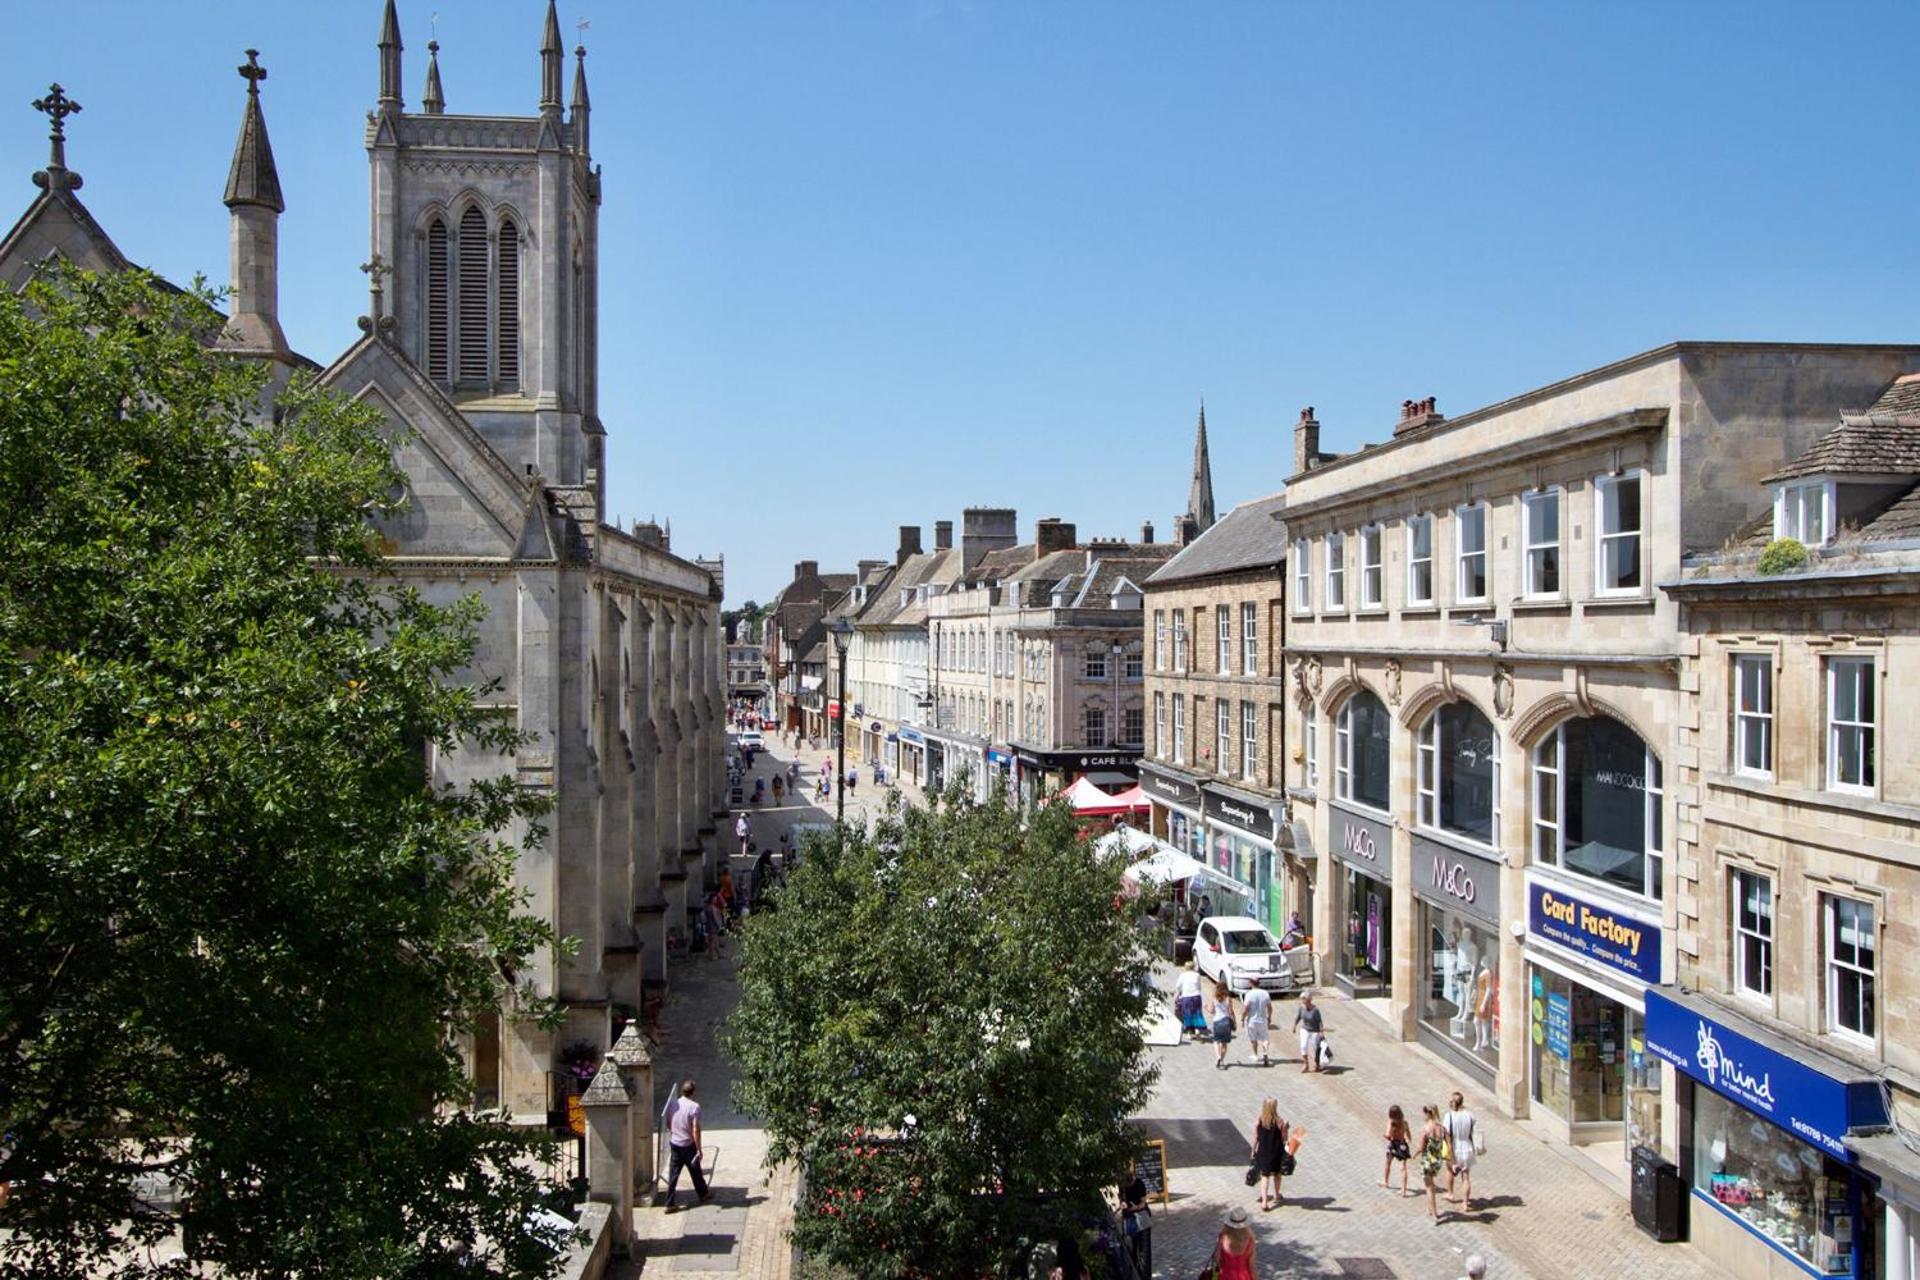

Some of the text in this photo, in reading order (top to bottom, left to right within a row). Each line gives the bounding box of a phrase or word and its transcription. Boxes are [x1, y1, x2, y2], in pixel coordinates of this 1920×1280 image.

[1344, 823, 1376, 860] M&Co
[1431, 855, 1474, 901] M&Co
[1542, 892, 1641, 956] Card Factory
